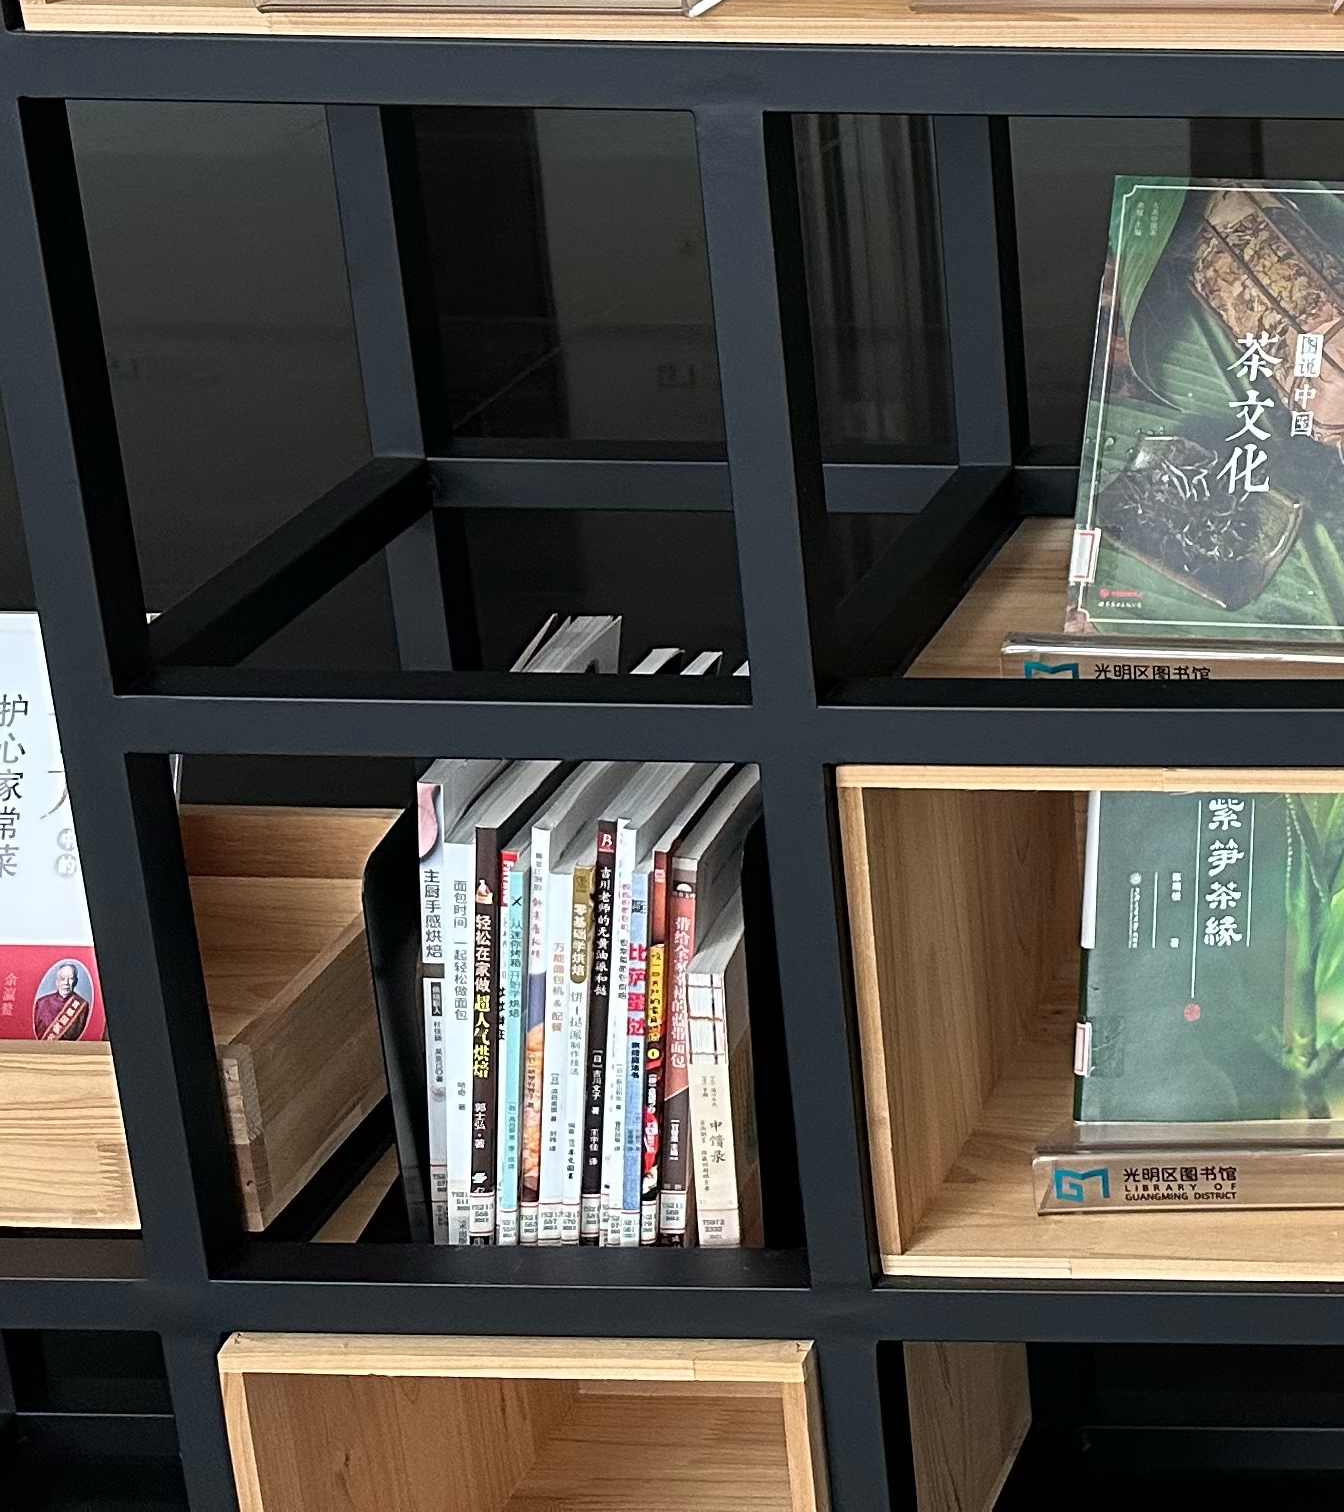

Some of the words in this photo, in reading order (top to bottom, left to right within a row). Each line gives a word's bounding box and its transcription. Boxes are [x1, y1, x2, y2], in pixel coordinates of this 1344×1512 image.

[1291, 335, 1321, 437] 图说中国
[1216, 330, 1284, 494] 茶文化
[1094, 663, 1211, 679] 光明区图书馆
[424, 868, 443, 959] 主厨手感烘焙
[453, 880, 468, 929] 面包时间
[453, 941, 468, 1021] 一起轻松做面包
[709, 1119, 726, 1164] 中馈录
[1123, 1166, 1237, 1182] 光明区图书馆
[1124, 1184, 1197, 1192] LIBRARY
[1214, 1183, 1236, 1191] OF
[1125, 1192, 1189, 1201] GUANGMING
[1193, 1191, 1237, 1200] DISTRICT
